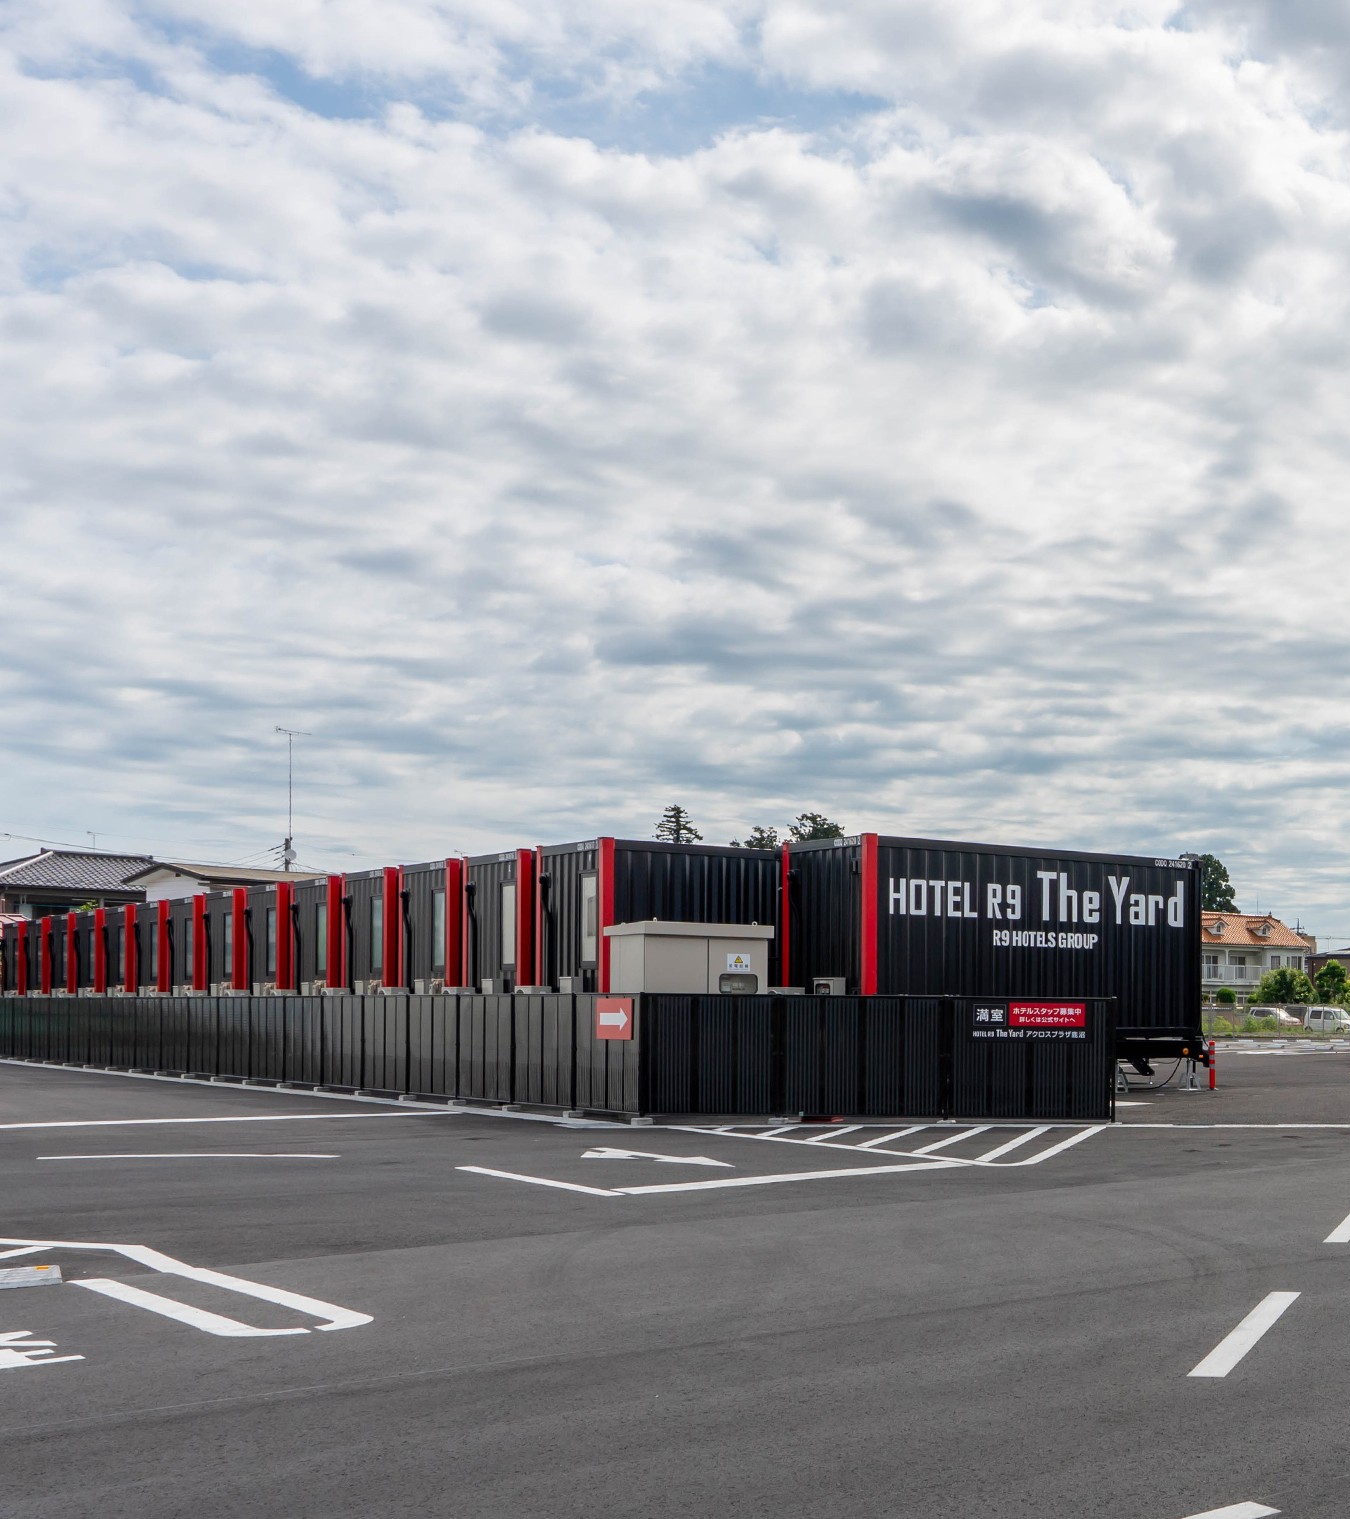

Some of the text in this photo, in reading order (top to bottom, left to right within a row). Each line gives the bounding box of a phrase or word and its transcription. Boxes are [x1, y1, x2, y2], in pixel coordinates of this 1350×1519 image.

[889, 870, 1185, 928] HOTEL R9 The Yard
[993, 929, 1098, 950] R9 HOTELS GROUP
[976, 1008, 1004, 1022] 満室
[1013, 1007, 1082, 1015] ホテルスタッフ募集中
[972, 1030, 987, 1038] HOTEL
[996, 1029, 1008, 1038] The
[1008, 1029, 1024, 1038] Yard
[1025, 1031, 1086, 1039] アクロスプラザ鹿沼
